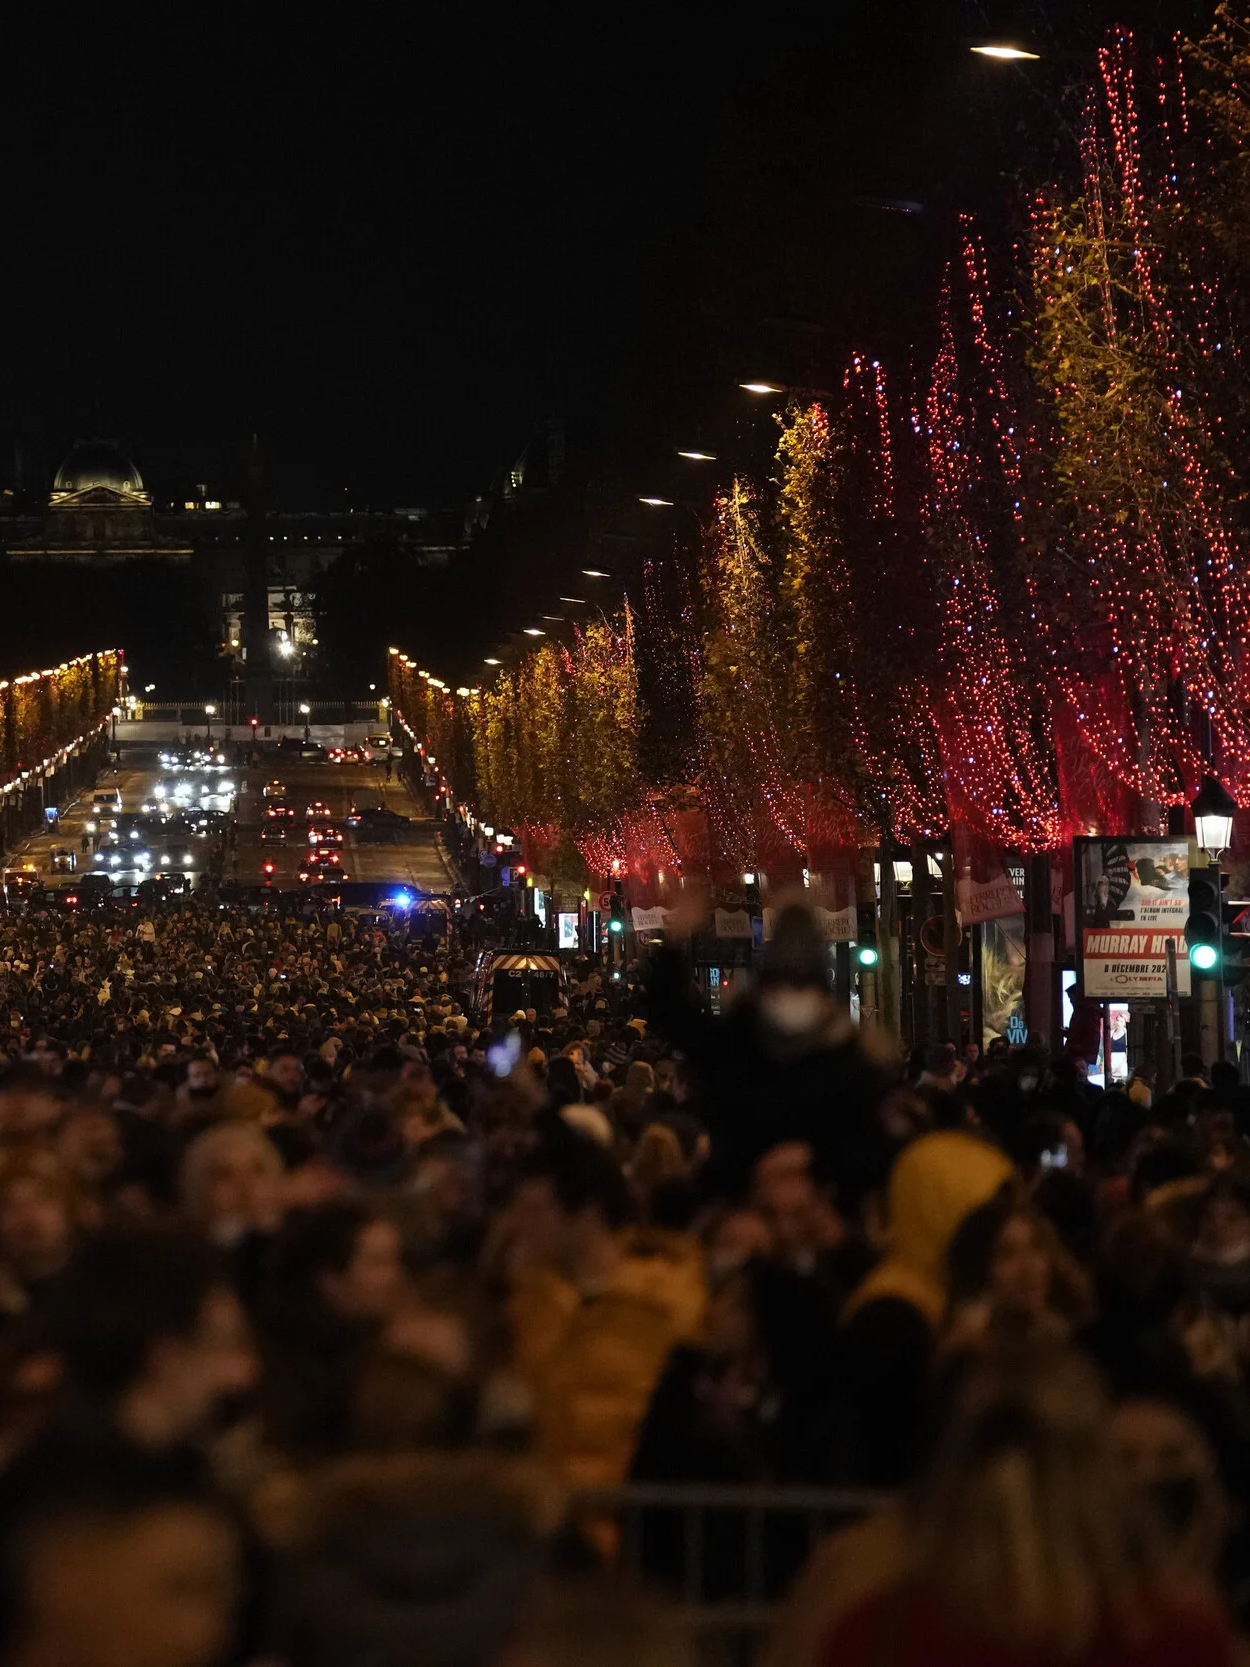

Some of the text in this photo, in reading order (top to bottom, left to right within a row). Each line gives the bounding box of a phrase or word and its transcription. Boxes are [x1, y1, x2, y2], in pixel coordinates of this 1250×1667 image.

[1086, 935, 1148, 954] MURRAY
[1112, 963, 1149, 973] DÉCEMBRE
[1151, 965, 1167, 973] 202
